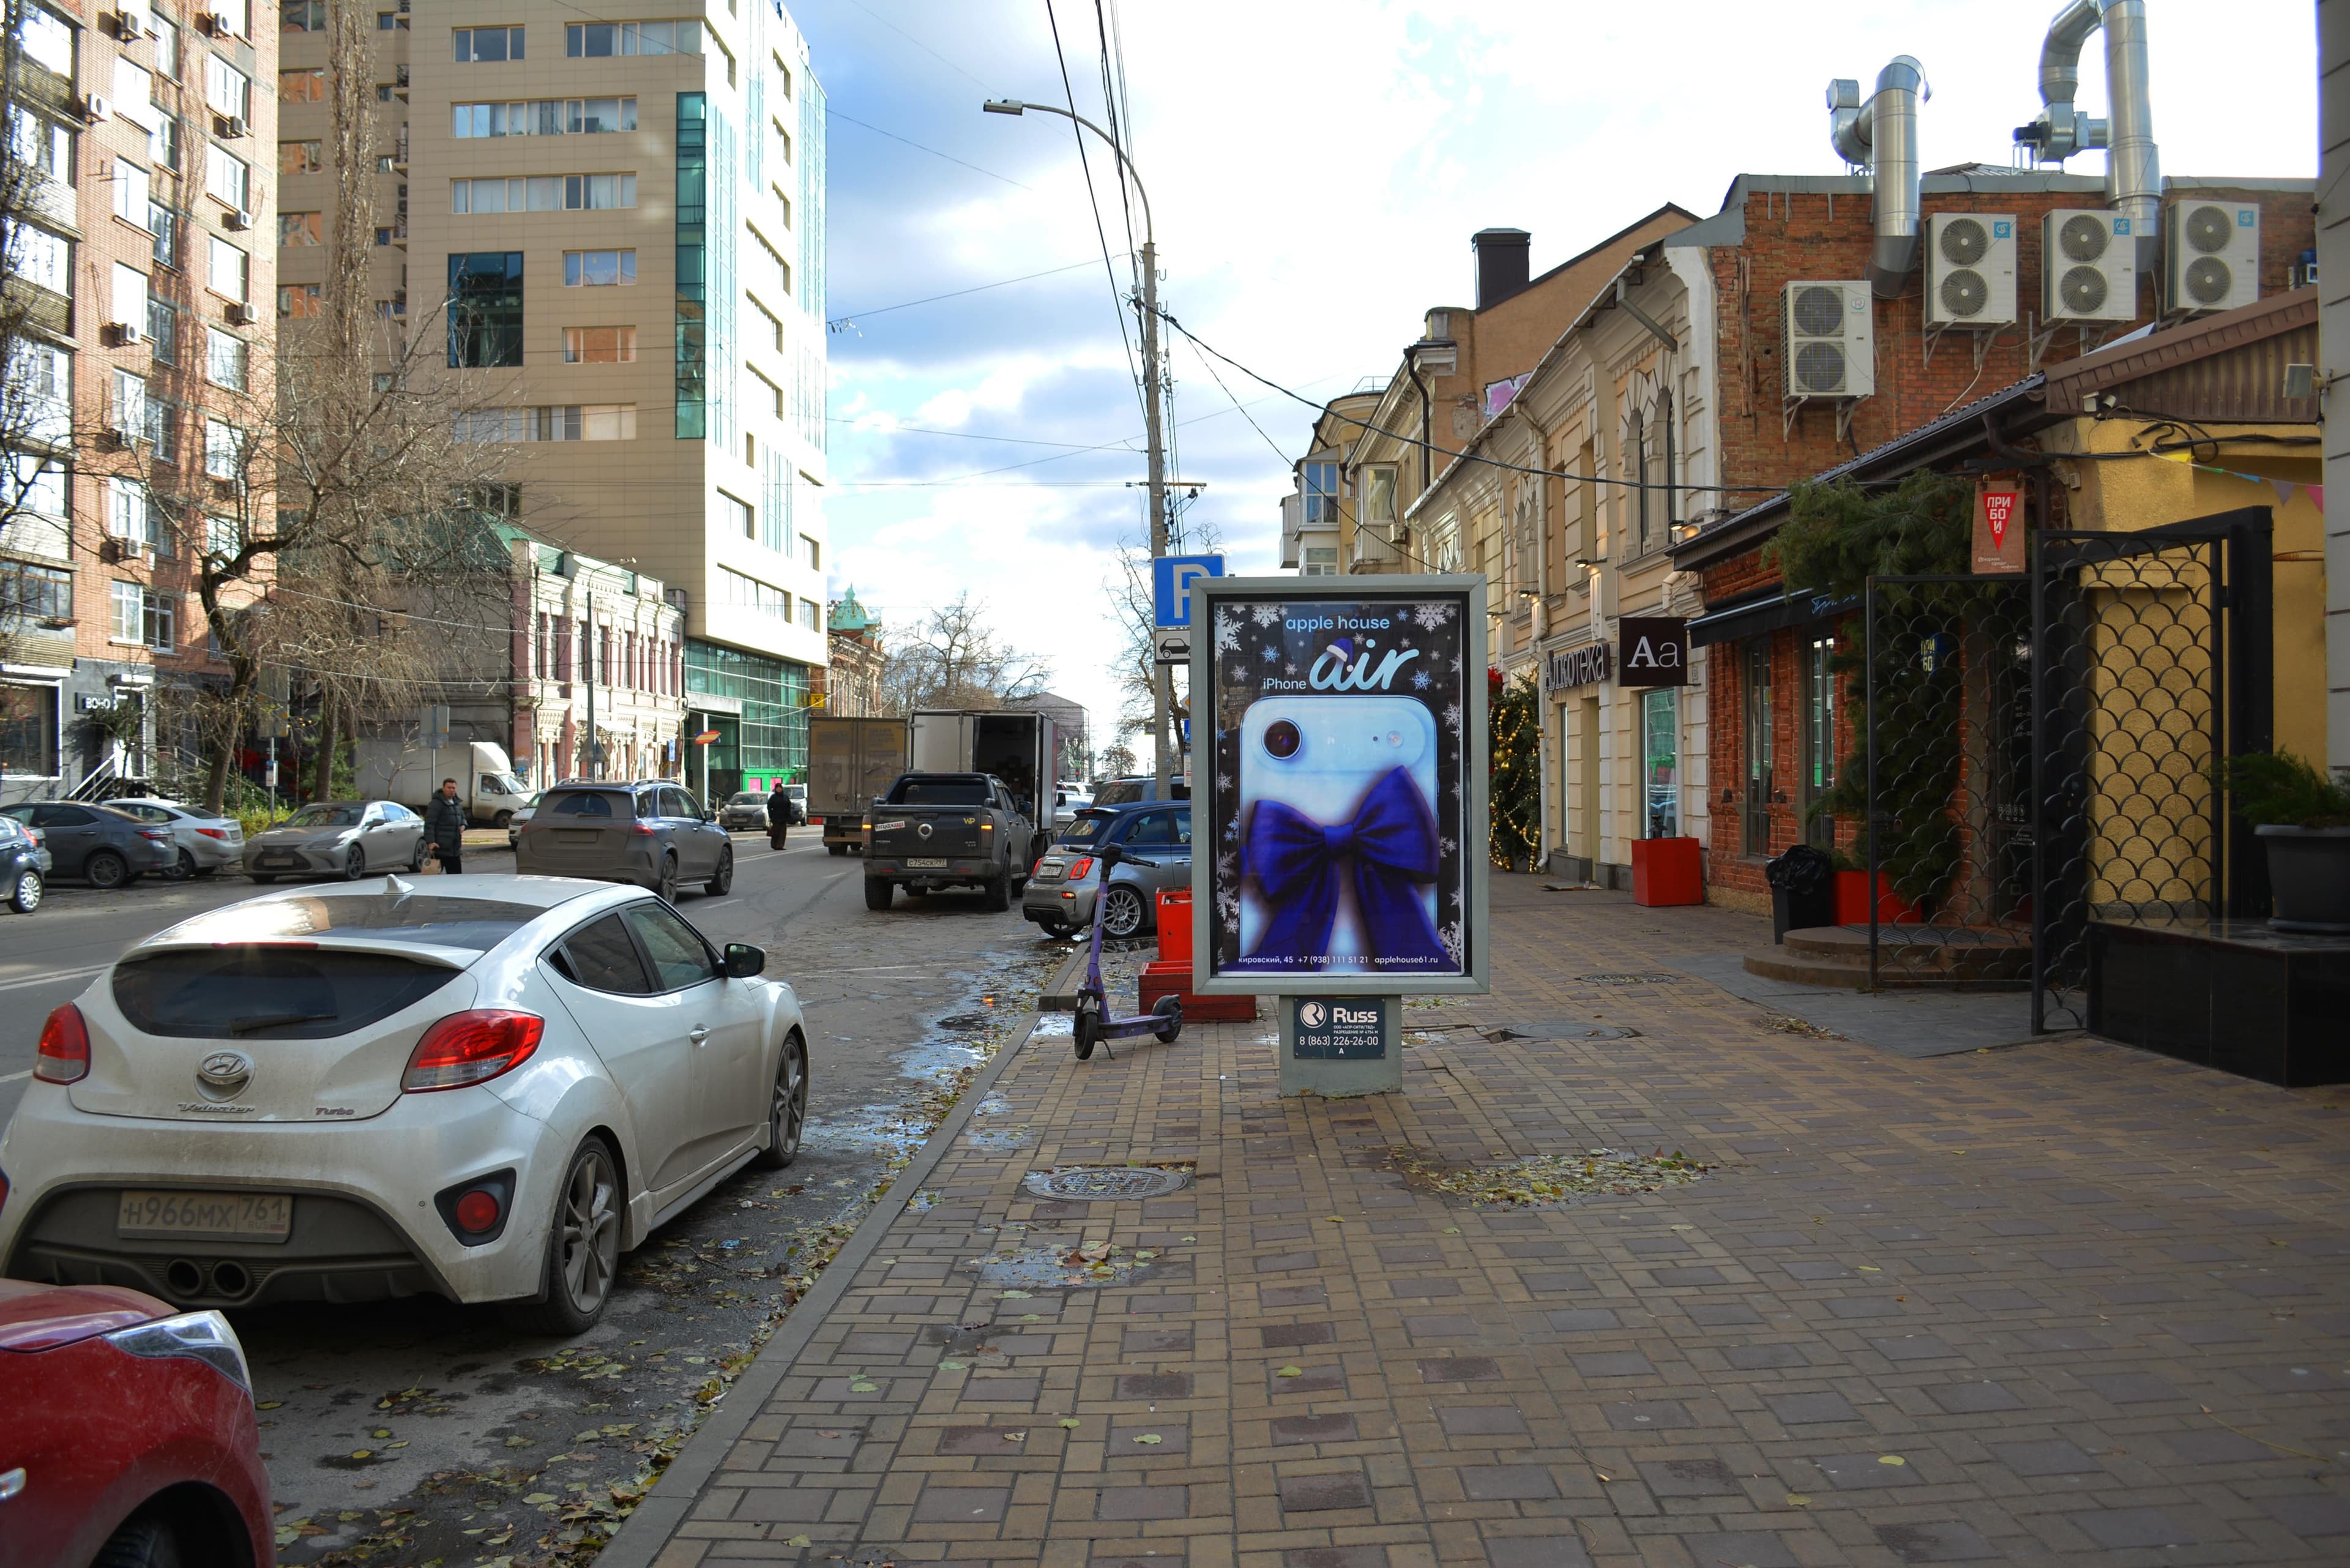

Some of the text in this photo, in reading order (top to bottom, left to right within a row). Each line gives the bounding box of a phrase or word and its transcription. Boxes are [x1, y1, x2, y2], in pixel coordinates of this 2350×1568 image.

[1987, 496, 2010, 508] ПРИ
[1990, 508, 2006, 520] БО
[1285, 615, 1390, 633] apple house
[1627, 635, 1680, 668] Aa
[1263, 639, 1420, 692] iPhone air
[1544, 642, 1605, 692] Алкотека
[1238, 955, 1282, 965] кировский,
[1310, 955, 1330, 965] (938)
[1375, 955, 1439, 965] applehouse61.ru
[1333, 1007, 1378, 1023] Russ
[1299, 1035, 1379, 1047] 8 (863) 226-26-00
[315, 1107, 355, 1116] Turbo
[241, 1197, 283, 1222] 761
